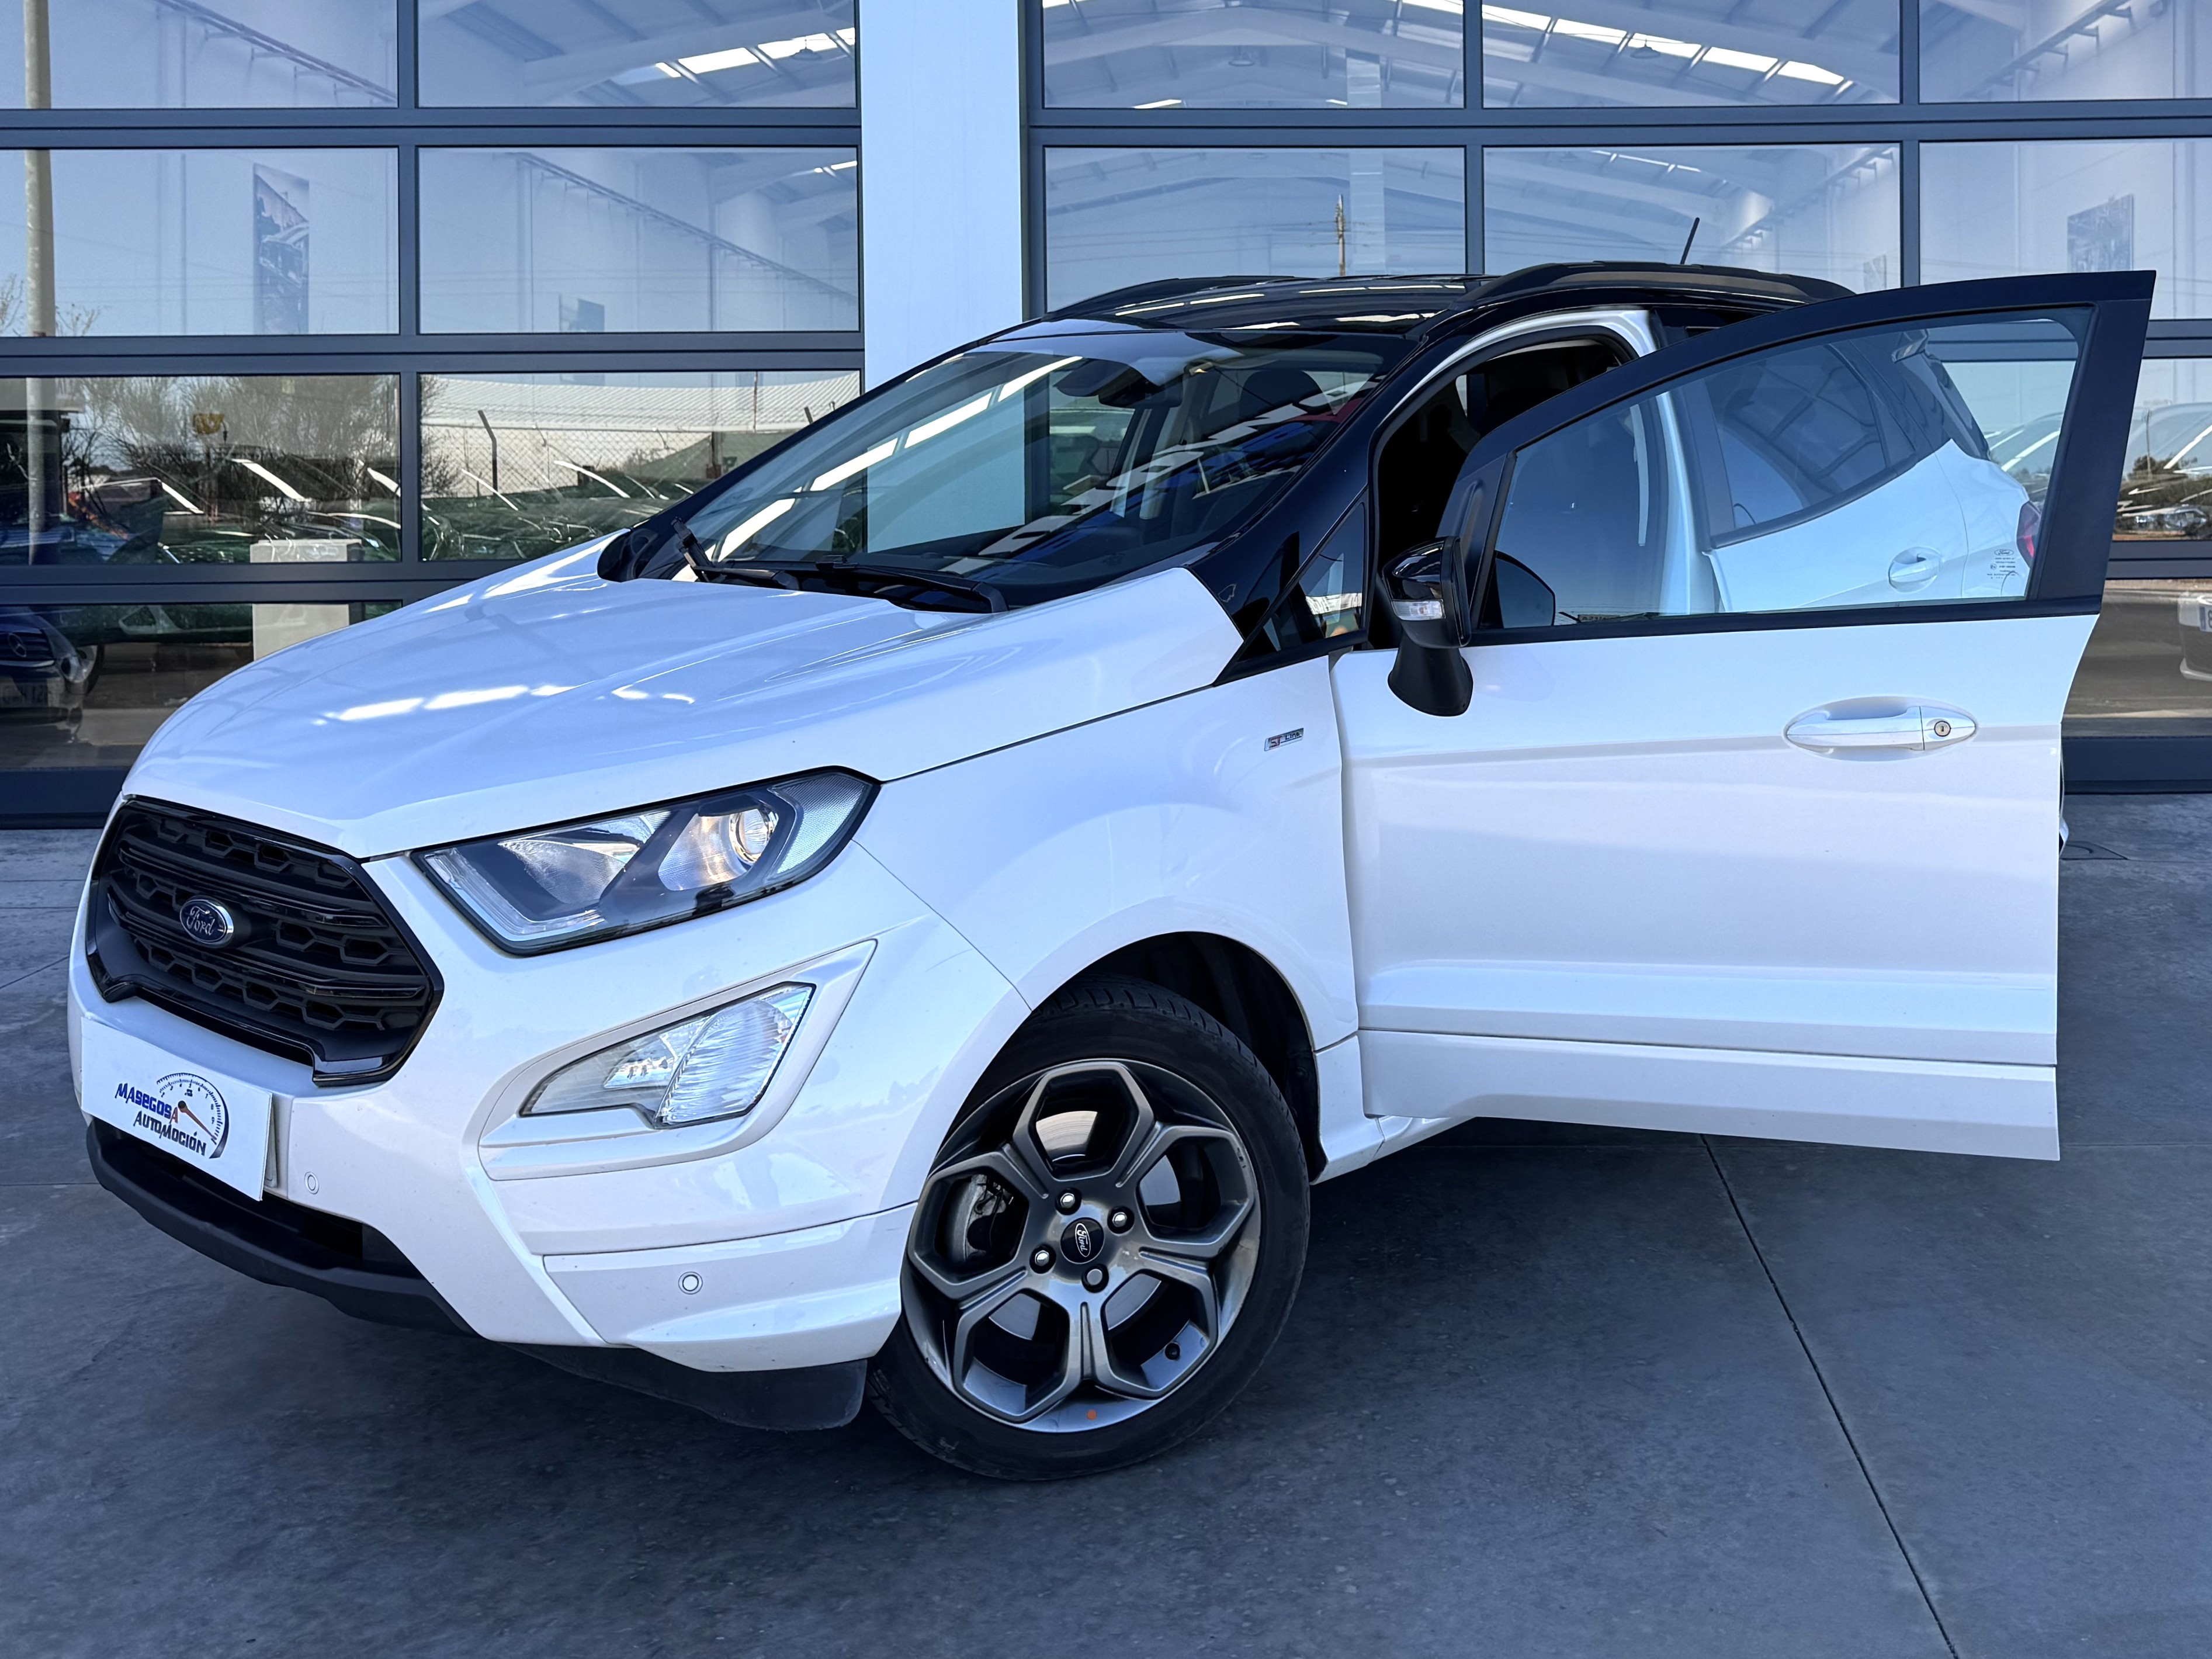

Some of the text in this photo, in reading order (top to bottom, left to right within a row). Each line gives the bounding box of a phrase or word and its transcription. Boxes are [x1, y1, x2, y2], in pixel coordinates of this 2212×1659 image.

[186, 906, 215, 936] Ford
[133, 1110, 207, 1156] AUTOMOCIÓN
[1077, 1229, 1088, 1252] Ford
